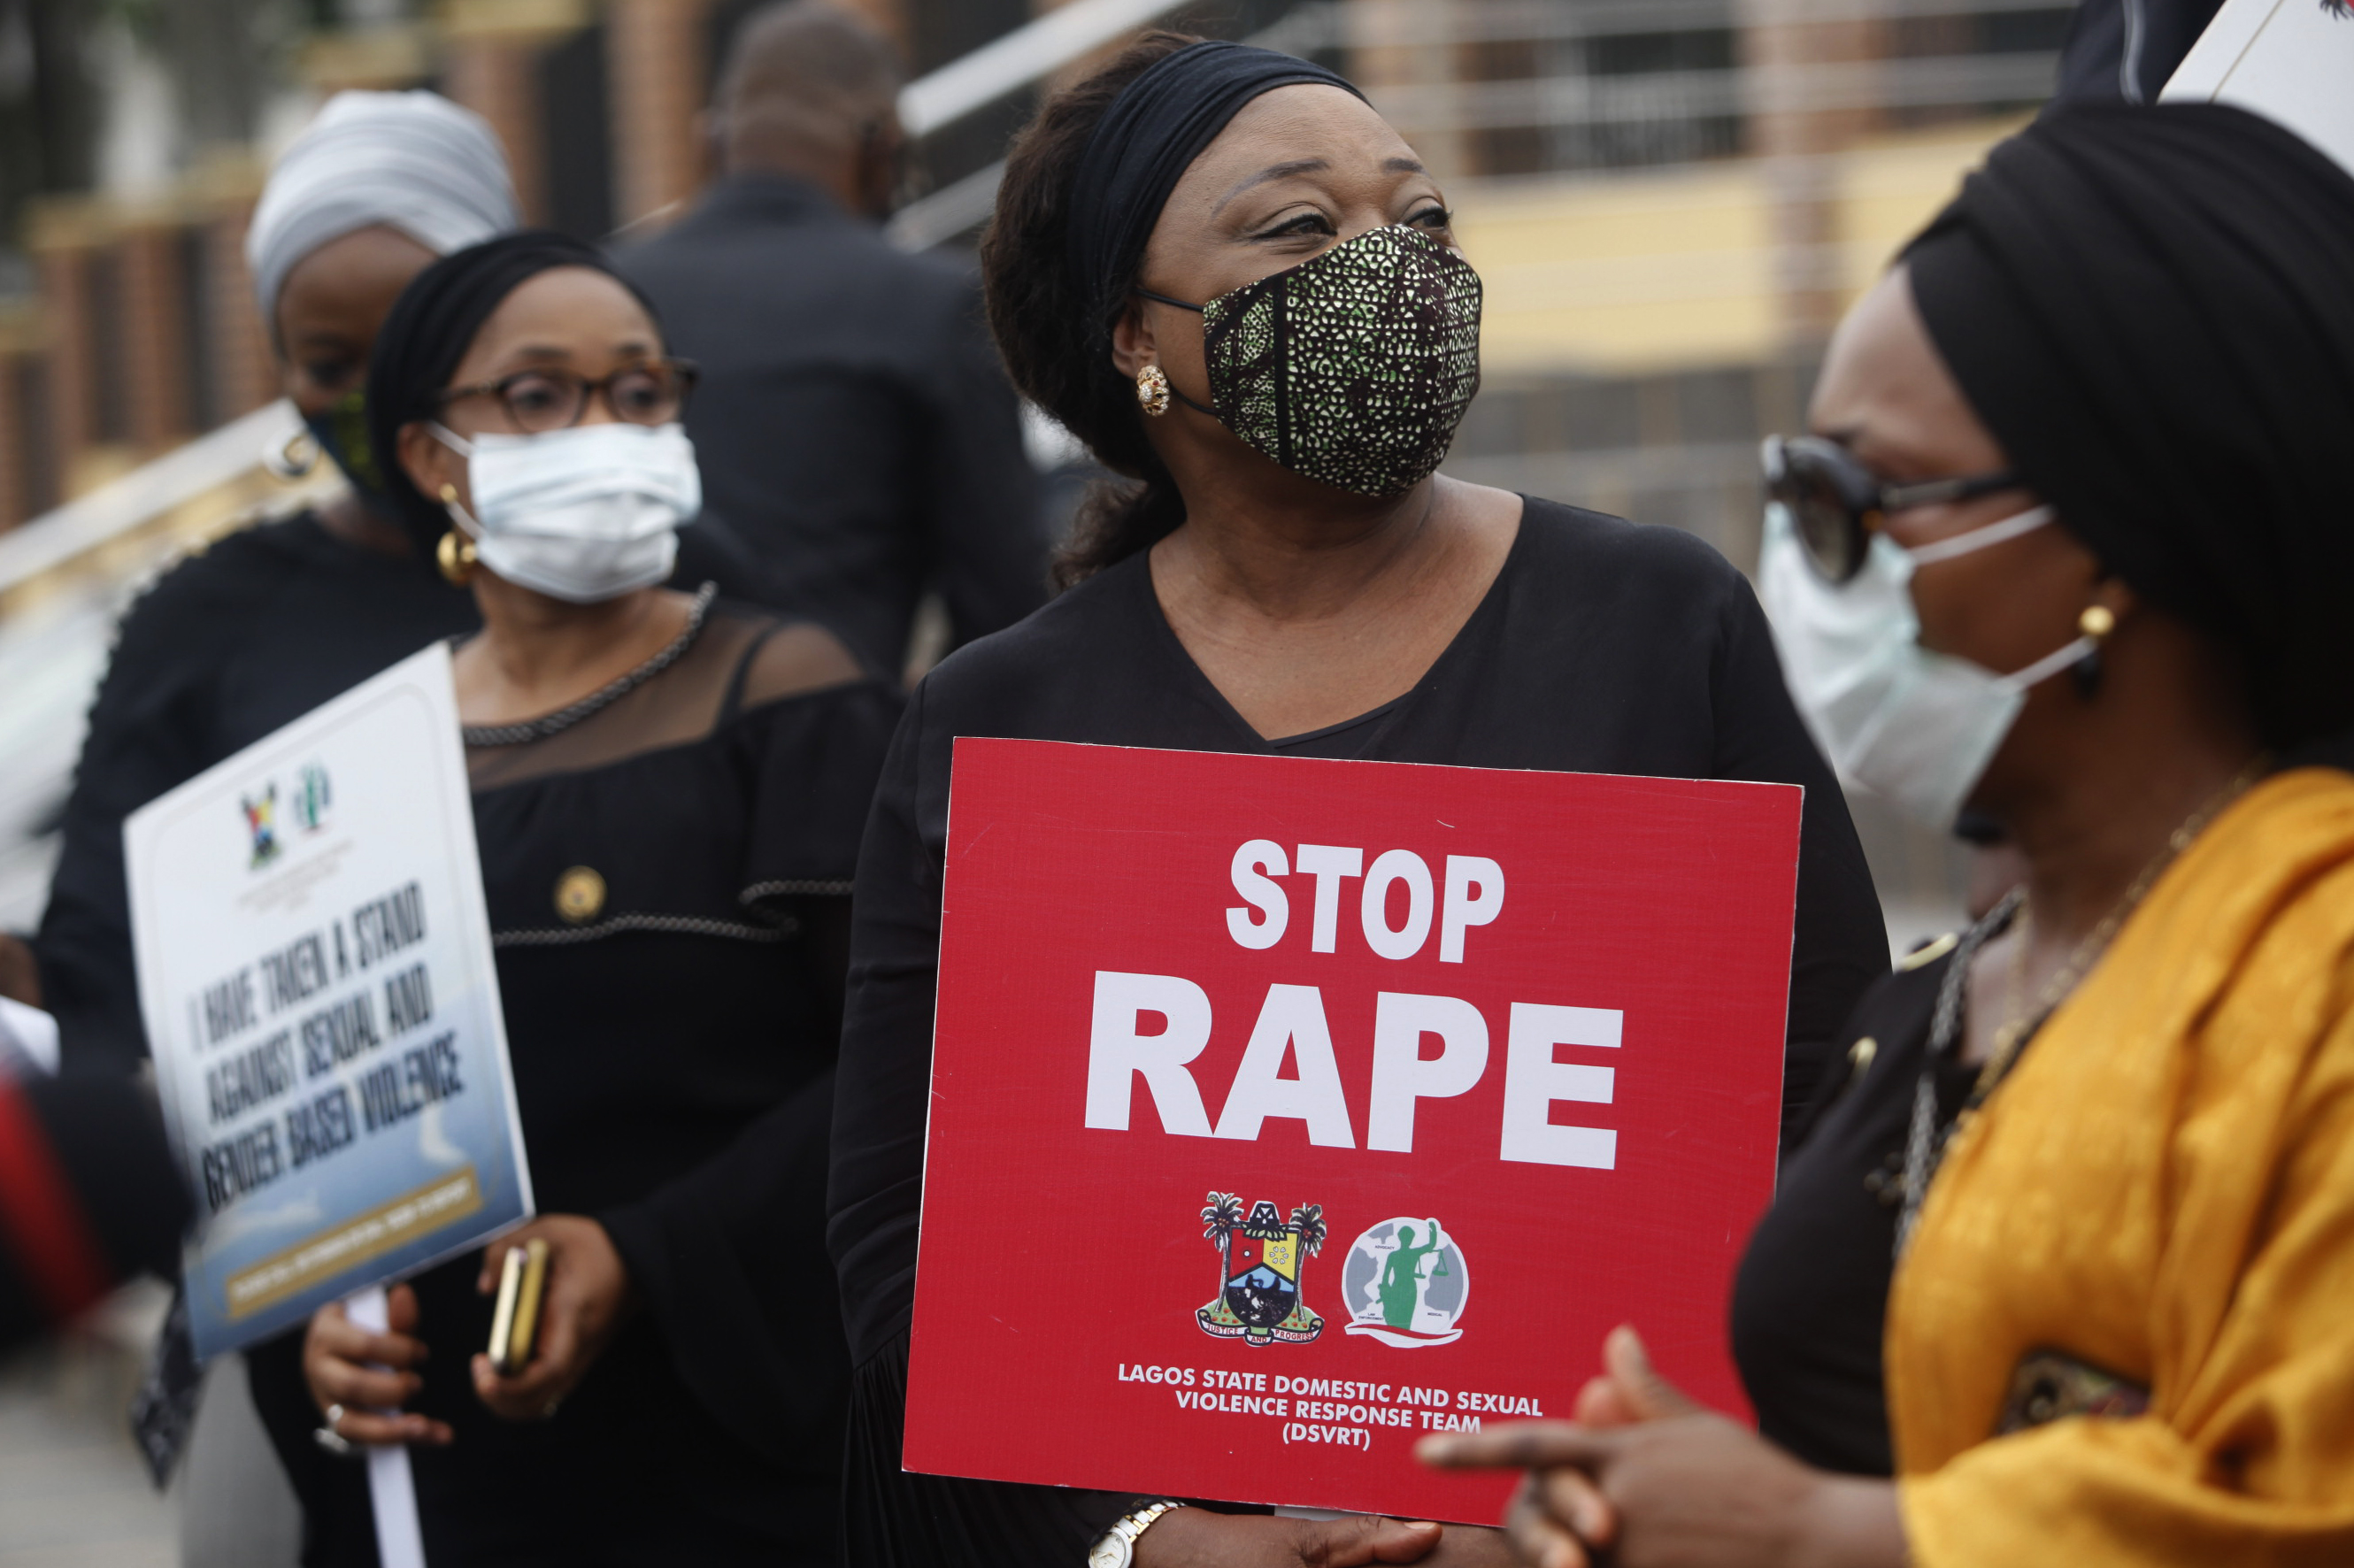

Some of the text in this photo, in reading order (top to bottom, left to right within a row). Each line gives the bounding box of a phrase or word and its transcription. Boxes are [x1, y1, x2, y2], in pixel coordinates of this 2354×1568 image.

[204, 964, 258, 1045] HAVE
[333, 919, 350, 977] A
[353, 881, 426, 968] STAND
[1226, 839, 1505, 964] STOP
[204, 960, 434, 1126] AGAINST SEXUAL AND
[1085, 971, 1623, 1170] RAPE
[201, 1028, 465, 1214] GENDER BASED VIOLENCE
[1118, 1364, 1543, 1417] LAGOS STATE DOMESTIC AND SEXUAL
[1206, 1324, 1238, 1335] JUSTICE
[1275, 1329, 1314, 1341] PROGRESS
[1175, 1390, 1481, 1434] VIOLENCE RESPONSE TEAM
[1282, 1422, 1371, 1452] (DSVRT)
